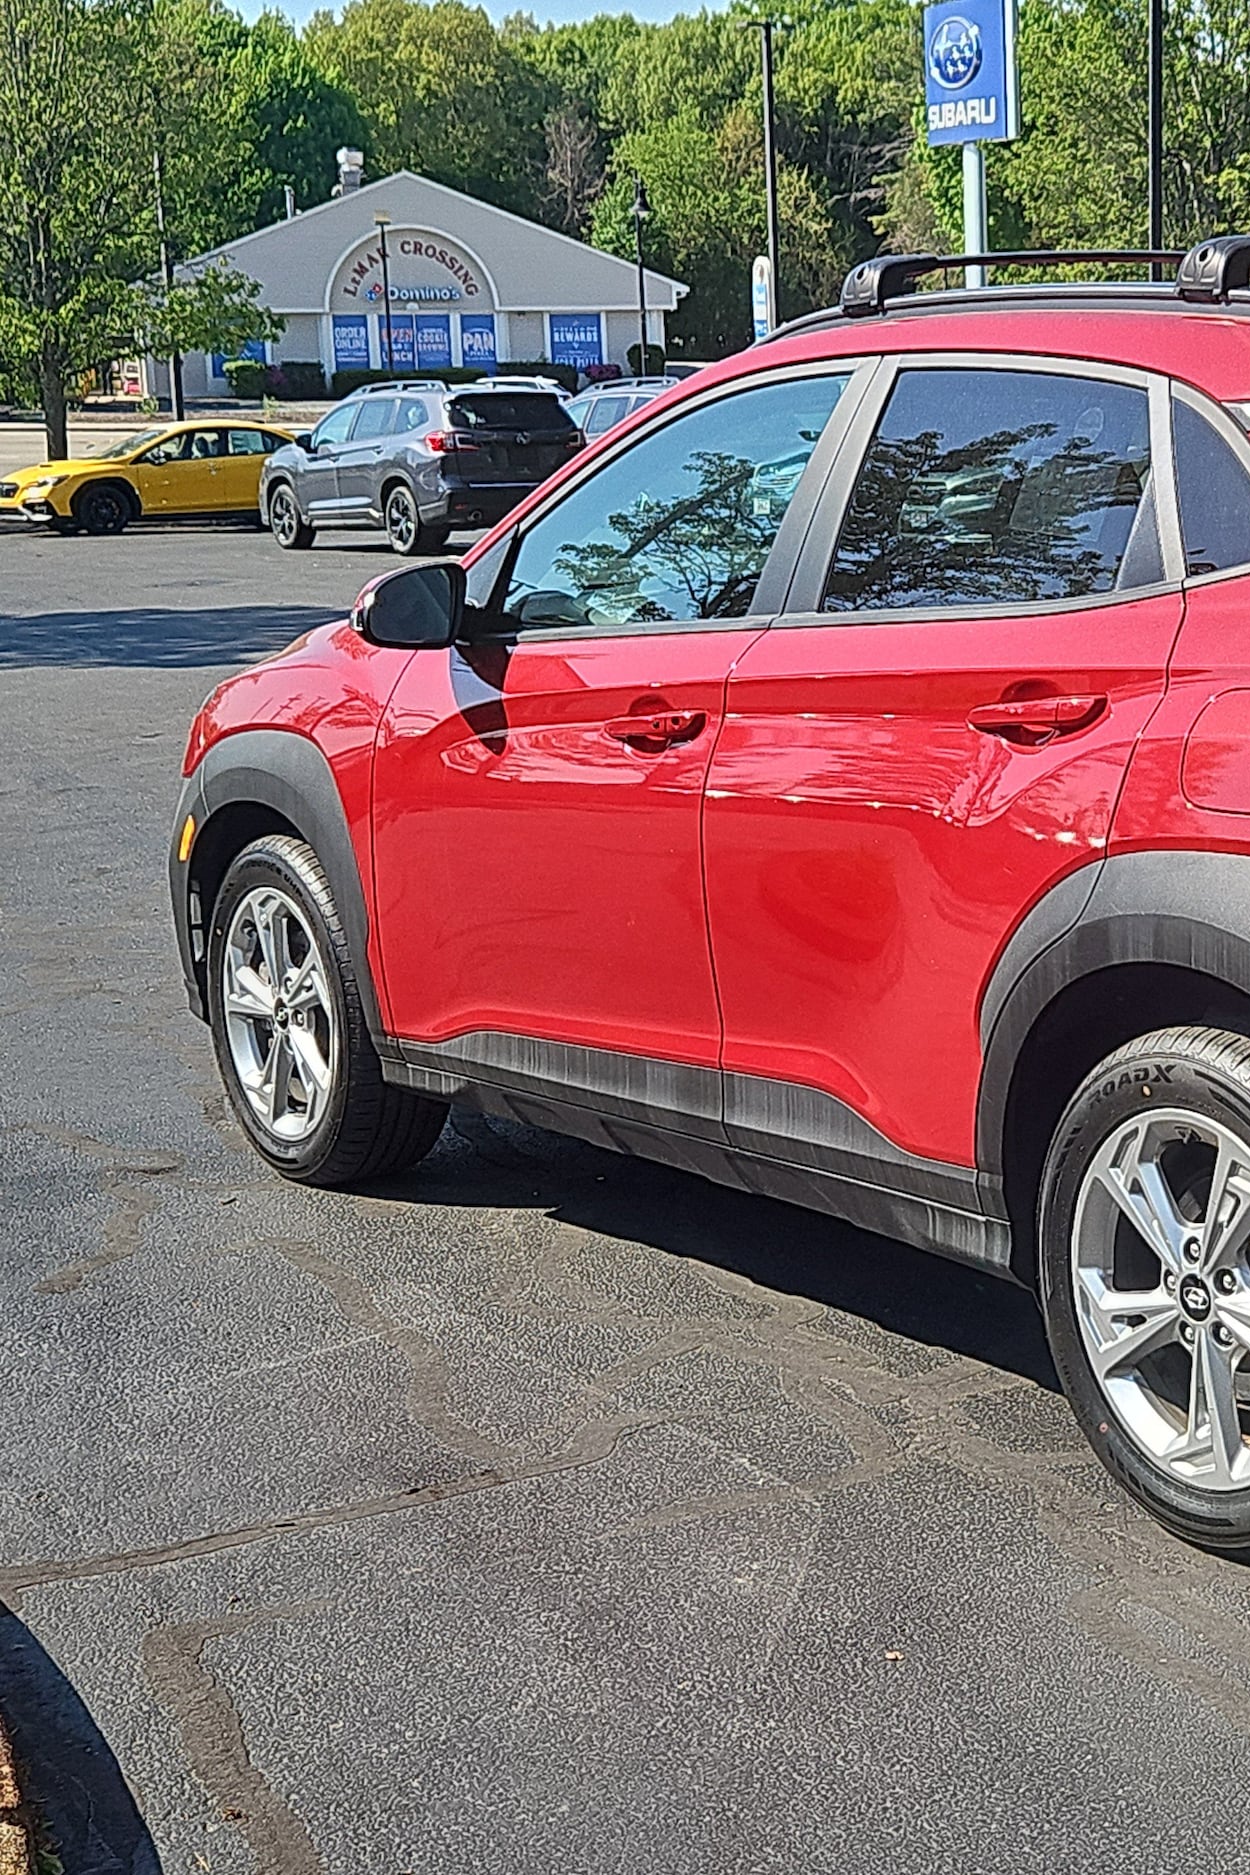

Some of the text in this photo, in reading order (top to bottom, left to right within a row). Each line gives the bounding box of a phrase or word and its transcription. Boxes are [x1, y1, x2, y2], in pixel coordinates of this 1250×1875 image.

[927, 96, 996, 131] SUBARU
[400, 240, 479, 296] CROSSING
[388, 286, 460, 301] Domino's
[462, 332, 495, 352] PAN
[553, 331, 598, 343] REWARDS
[382, 351, 413, 363] LNCH
